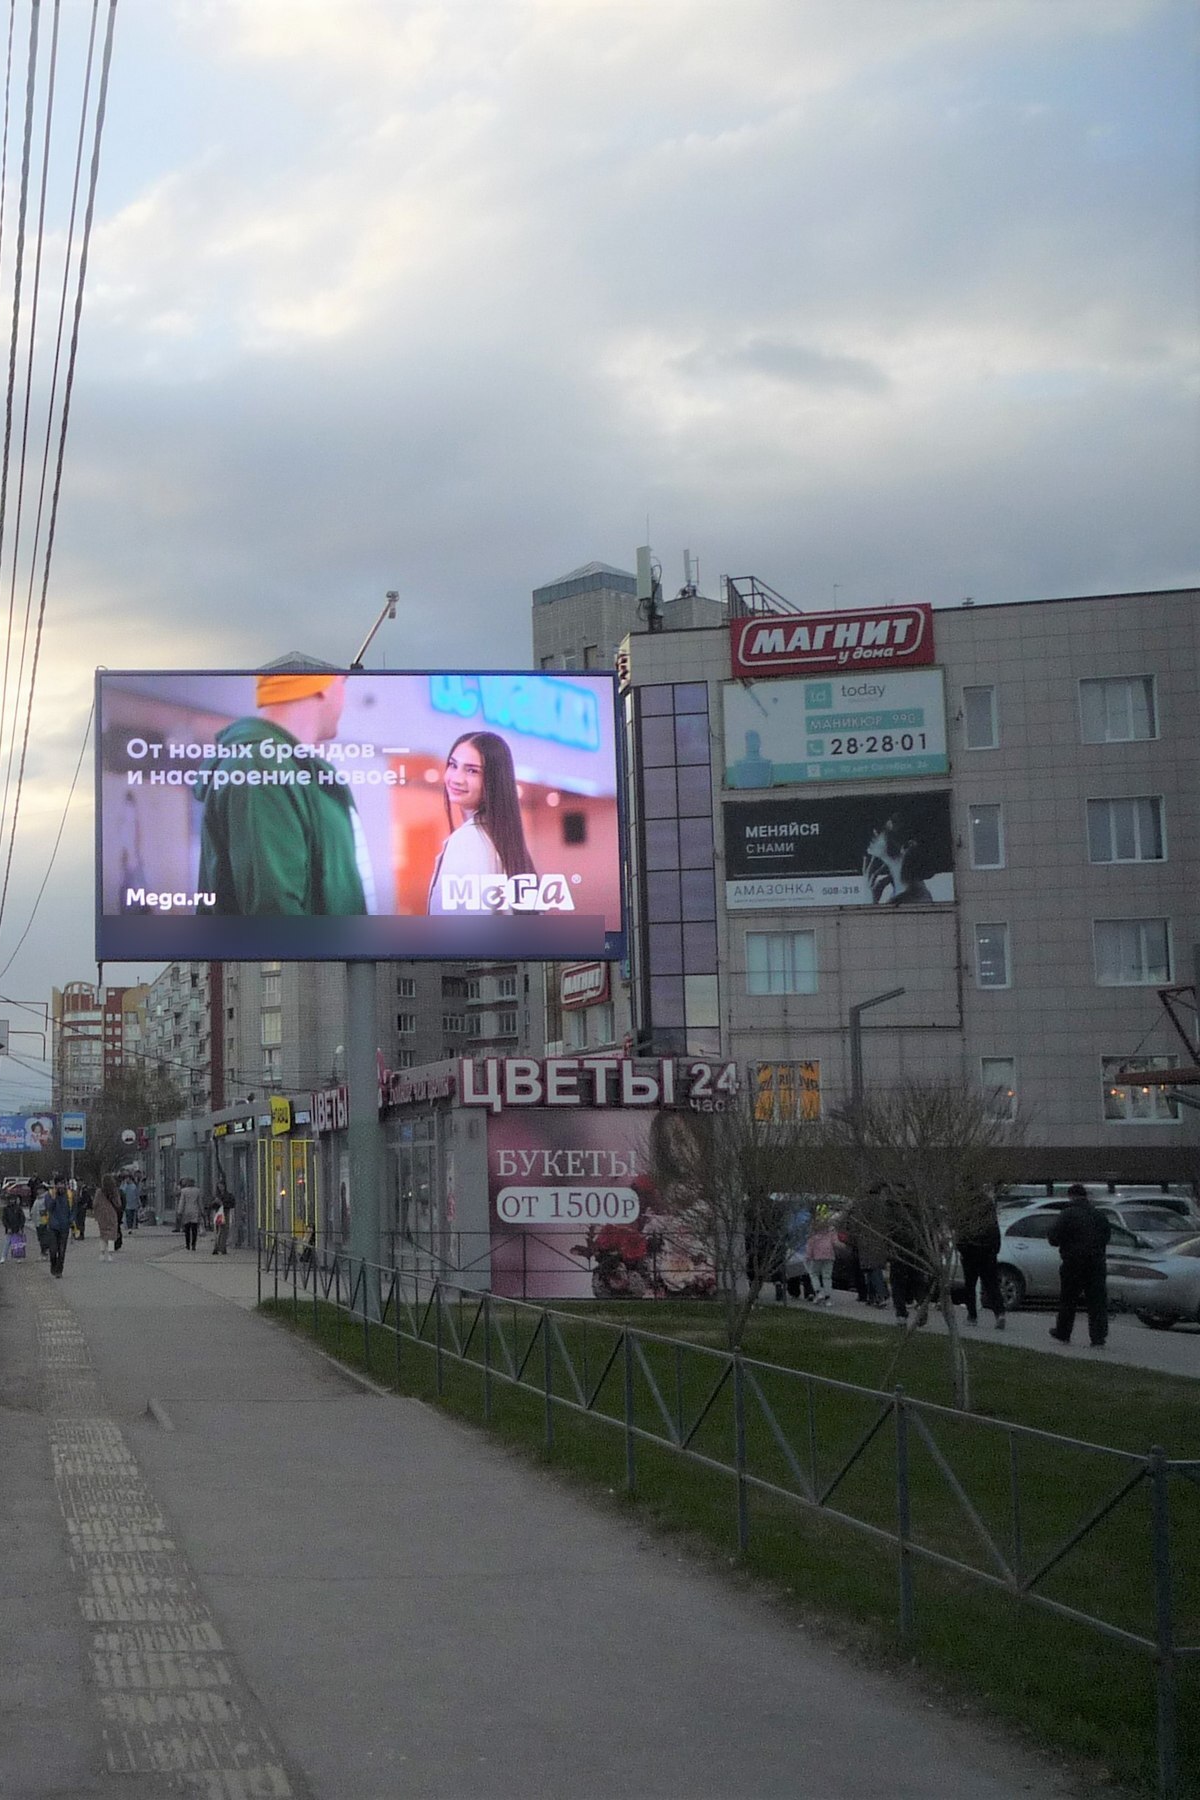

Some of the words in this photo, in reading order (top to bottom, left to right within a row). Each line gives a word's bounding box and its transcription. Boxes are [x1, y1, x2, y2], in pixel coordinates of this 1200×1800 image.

[751, 619, 913, 654] МАГНИТ
[838, 652, 850, 664] у
[853, 647, 894, 660] дома
[842, 683, 885, 698] today
[810, 716, 882, 731] МАНИКЮР
[126, 738, 163, 759] От
[169, 742, 252, 759] новых
[259, 738, 375, 763] брендов
[127, 770, 143, 785] и
[150, 769, 311, 790] настроение
[318, 765, 406, 785] новое!
[746, 822, 820, 838] МЕНЯЙСЯ
[746, 843, 755, 854] С
[757, 842, 795, 853] НАМИ
[126, 888, 217, 910] Mega.ru
[734, 883, 814, 897] АМАЗОНКА
[462, 1058, 675, 1113] ЦВЕТЫ
[689, 1062, 740, 1098] 24
[310, 1083, 349, 1140] ЦВЕТЫ
[497, 1149, 639, 1178] БУКЕТЫ
[501, 1196, 539, 1218] ОТ
